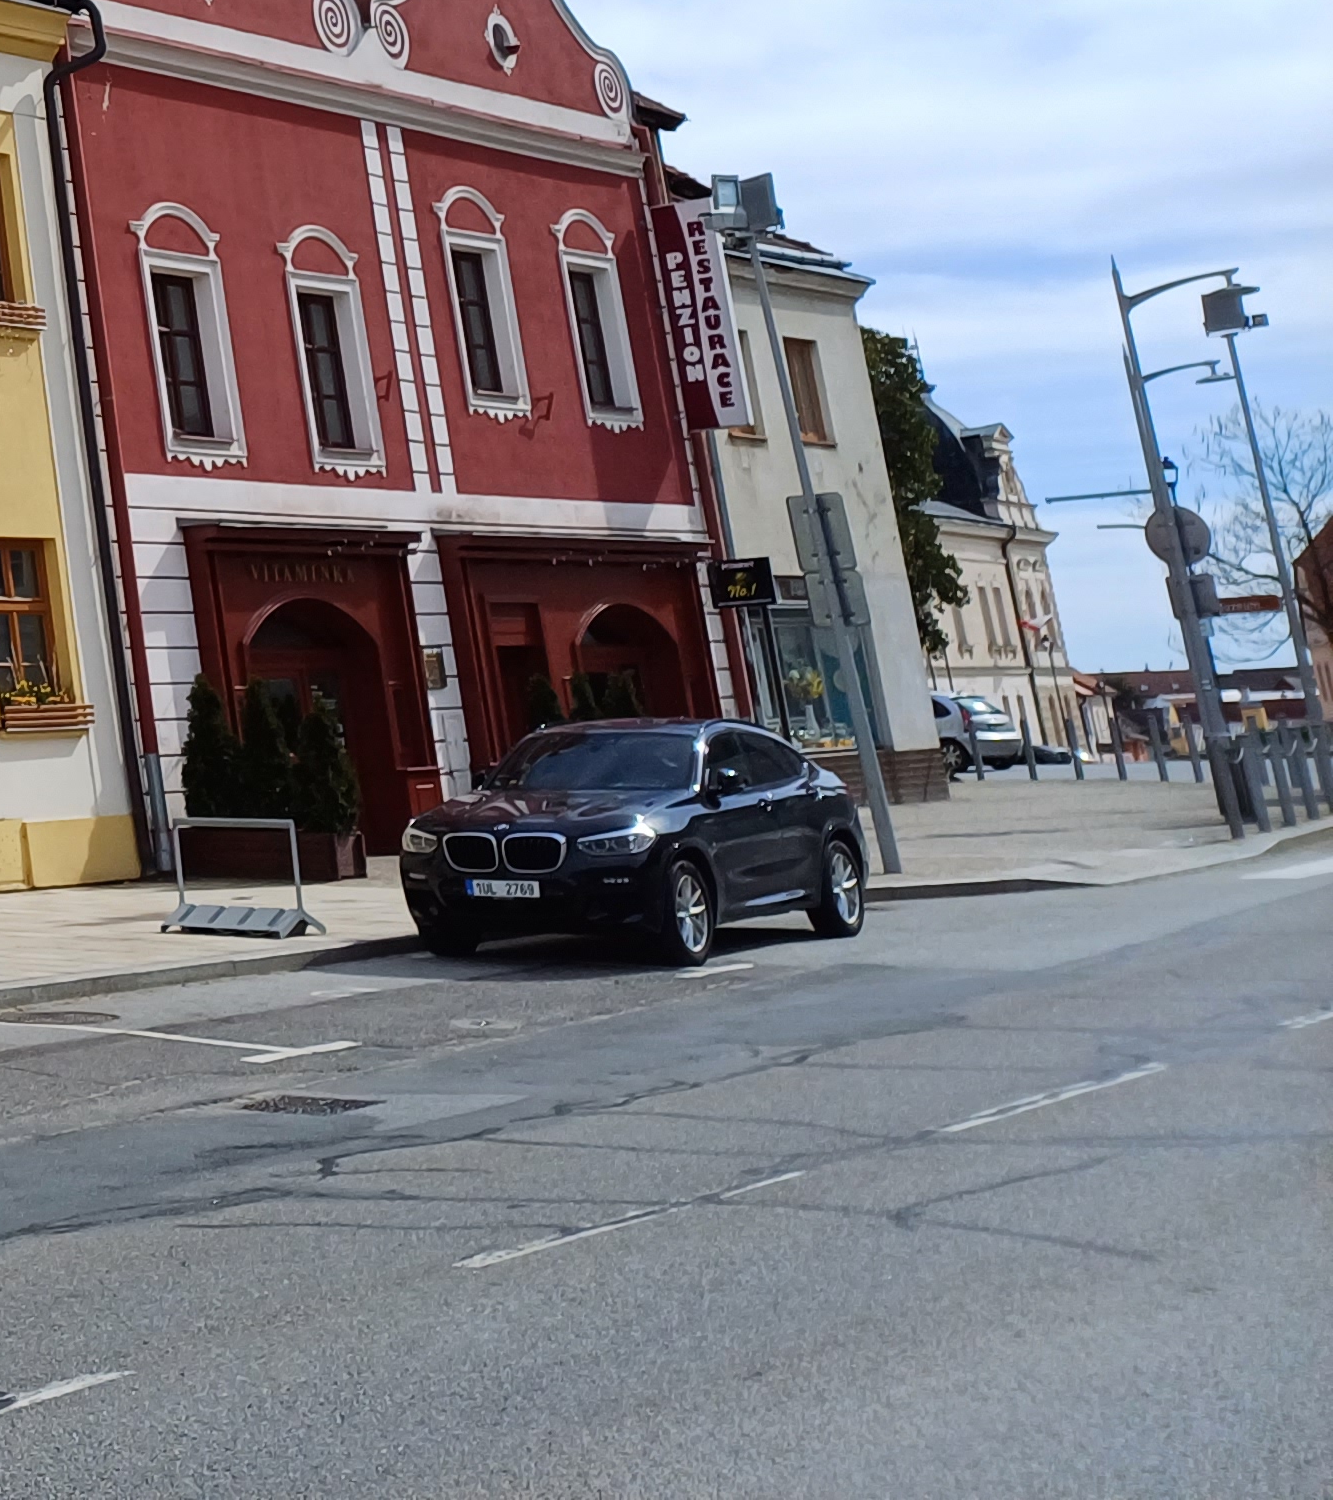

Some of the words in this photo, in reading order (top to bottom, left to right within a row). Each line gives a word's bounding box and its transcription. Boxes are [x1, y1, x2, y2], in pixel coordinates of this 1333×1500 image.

[665, 251, 705, 383] PENZION
[687, 220, 735, 408] RESTAURACE
[251, 563, 355, 583] VITAMINKA
